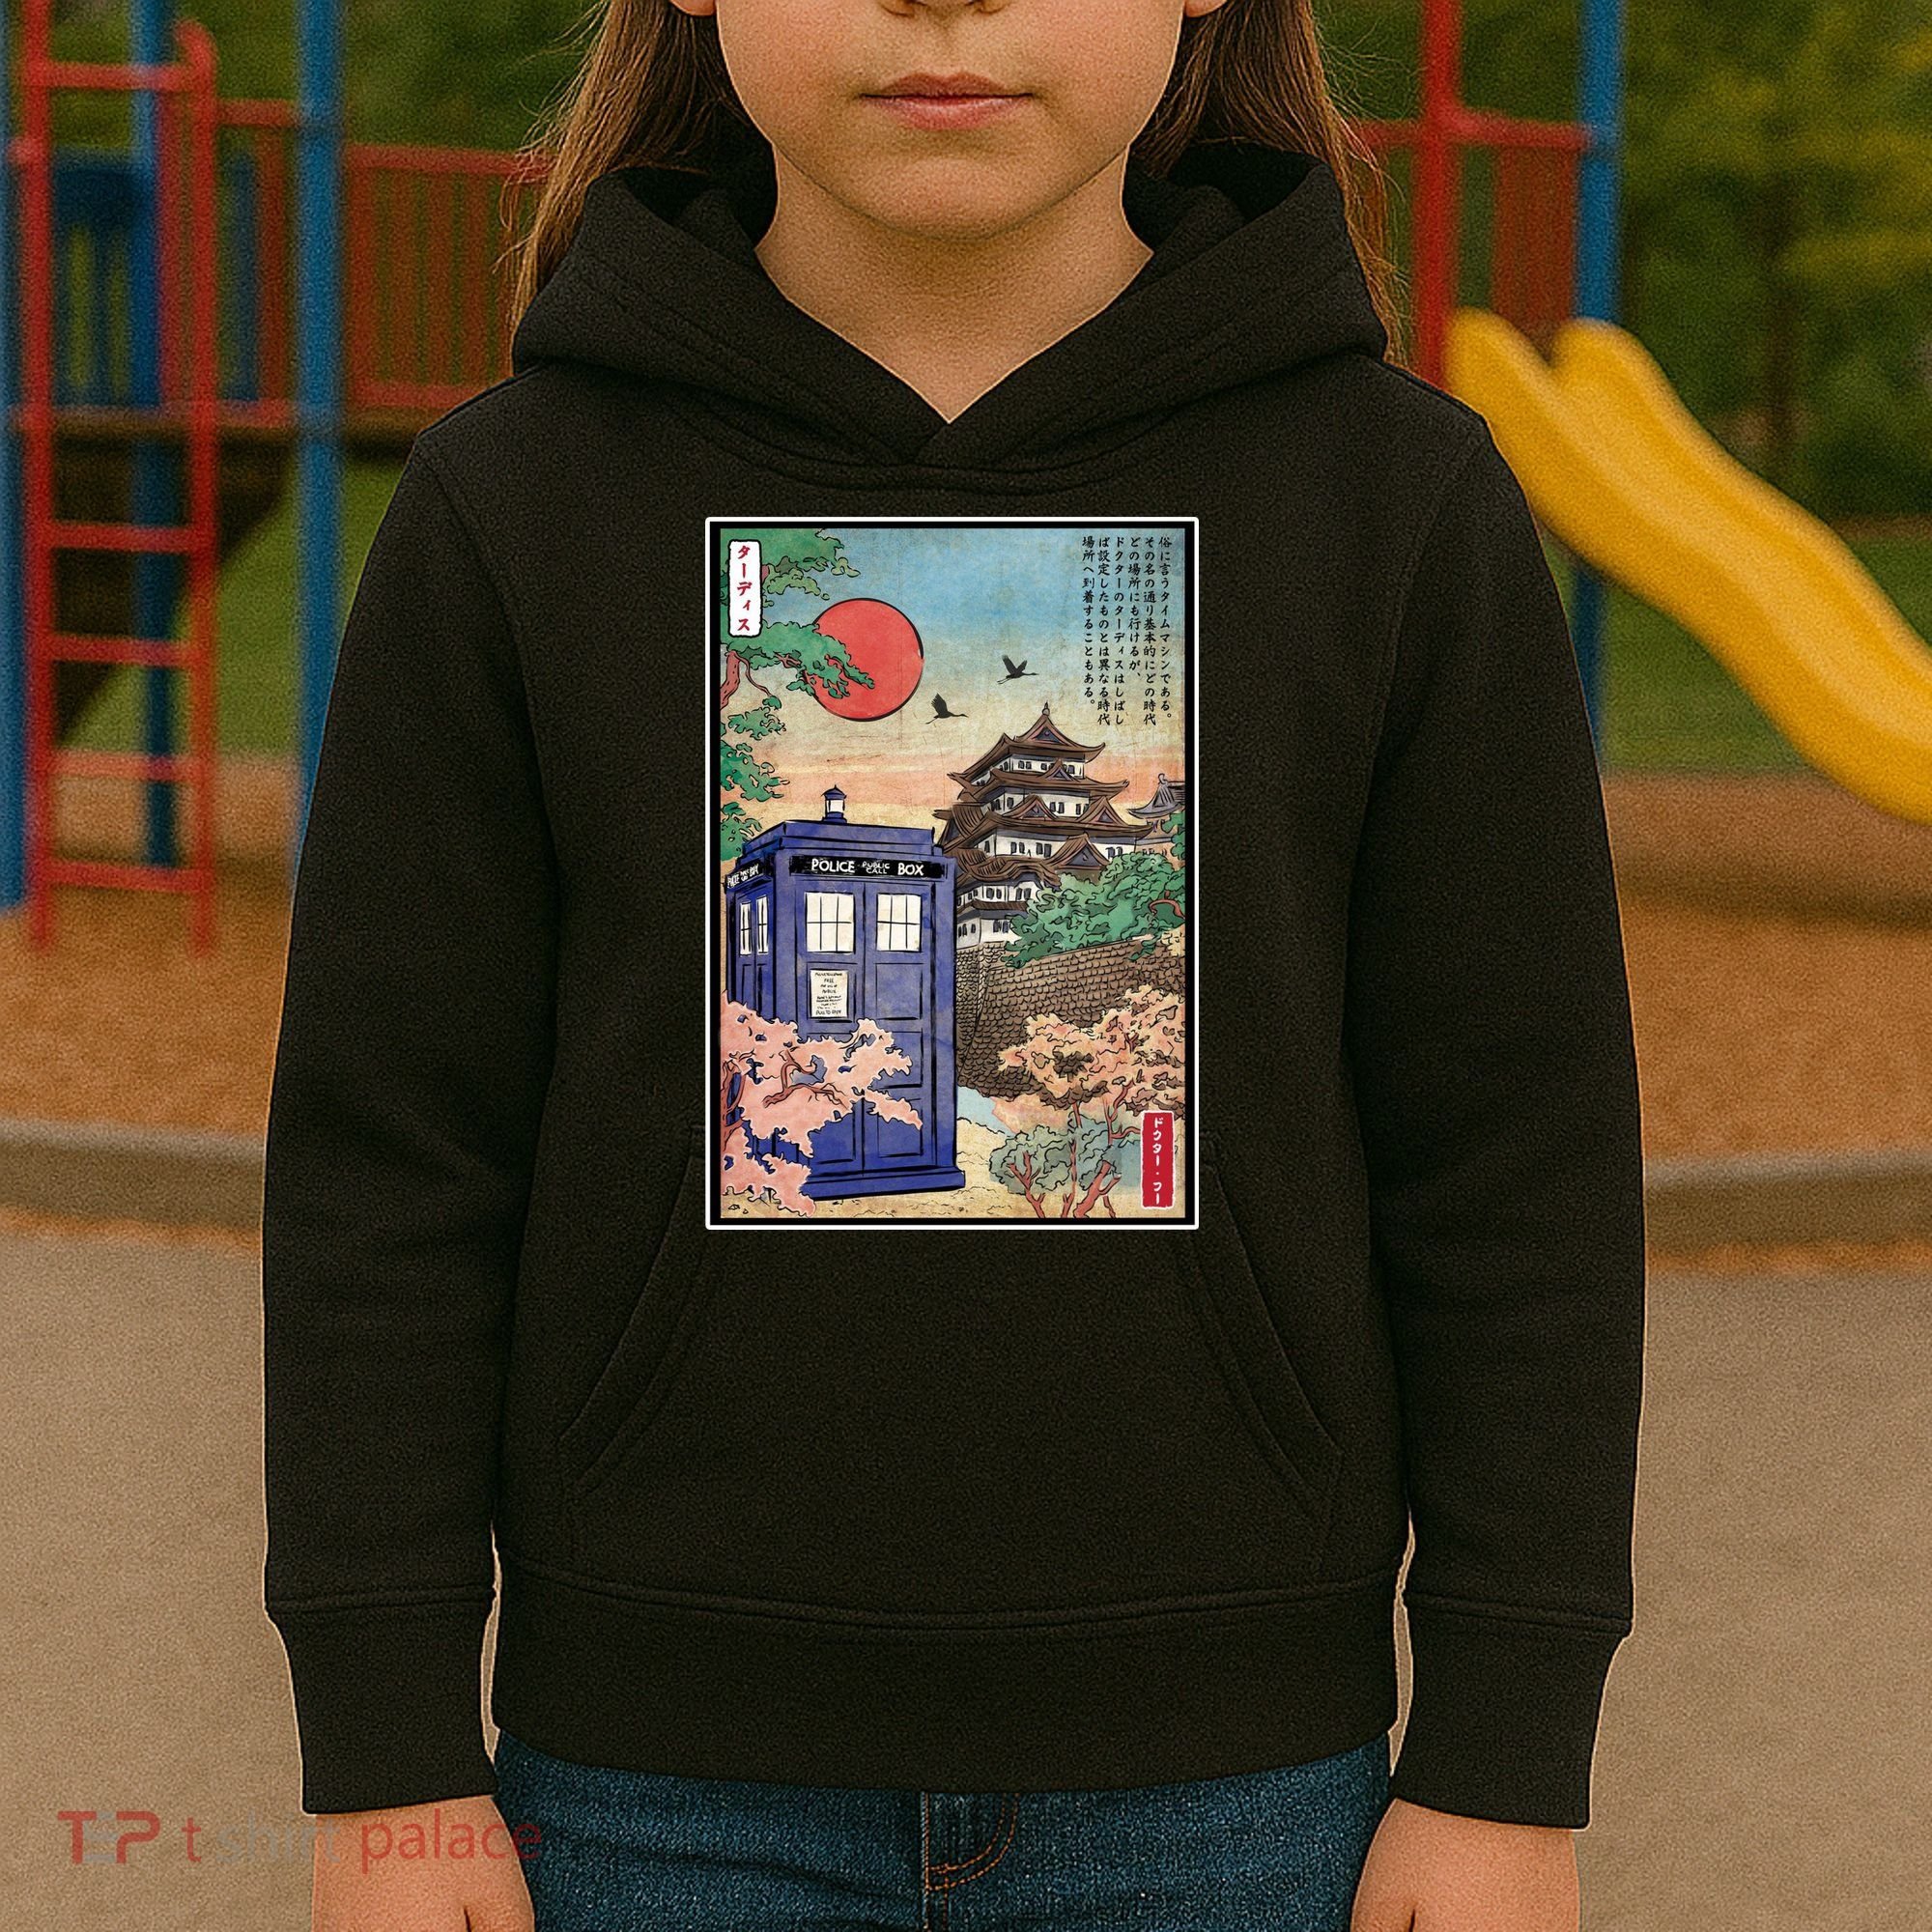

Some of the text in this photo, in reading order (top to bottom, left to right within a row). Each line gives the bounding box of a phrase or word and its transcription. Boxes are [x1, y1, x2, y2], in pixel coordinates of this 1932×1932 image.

[736, 545, 753, 632] ターディス
[1081, 536, 1095, 705] 場所へ到着することもある。
[1097, 536, 1111, 725] ば設定したものとは異なる時代
[1114, 536, 1125, 725] ドクターのターディスはしばし
[1128, 536, 1142, 677] どの場所にも行けるが、
[1143, 536, 1157, 725] その名の通り基本的にどの時代
[1158, 536, 1173, 719] 俗に言うタイムマシンである。
[811, 858, 924, 876] POLICE BOX
[862, 861, 891, 869] PUBLIC
